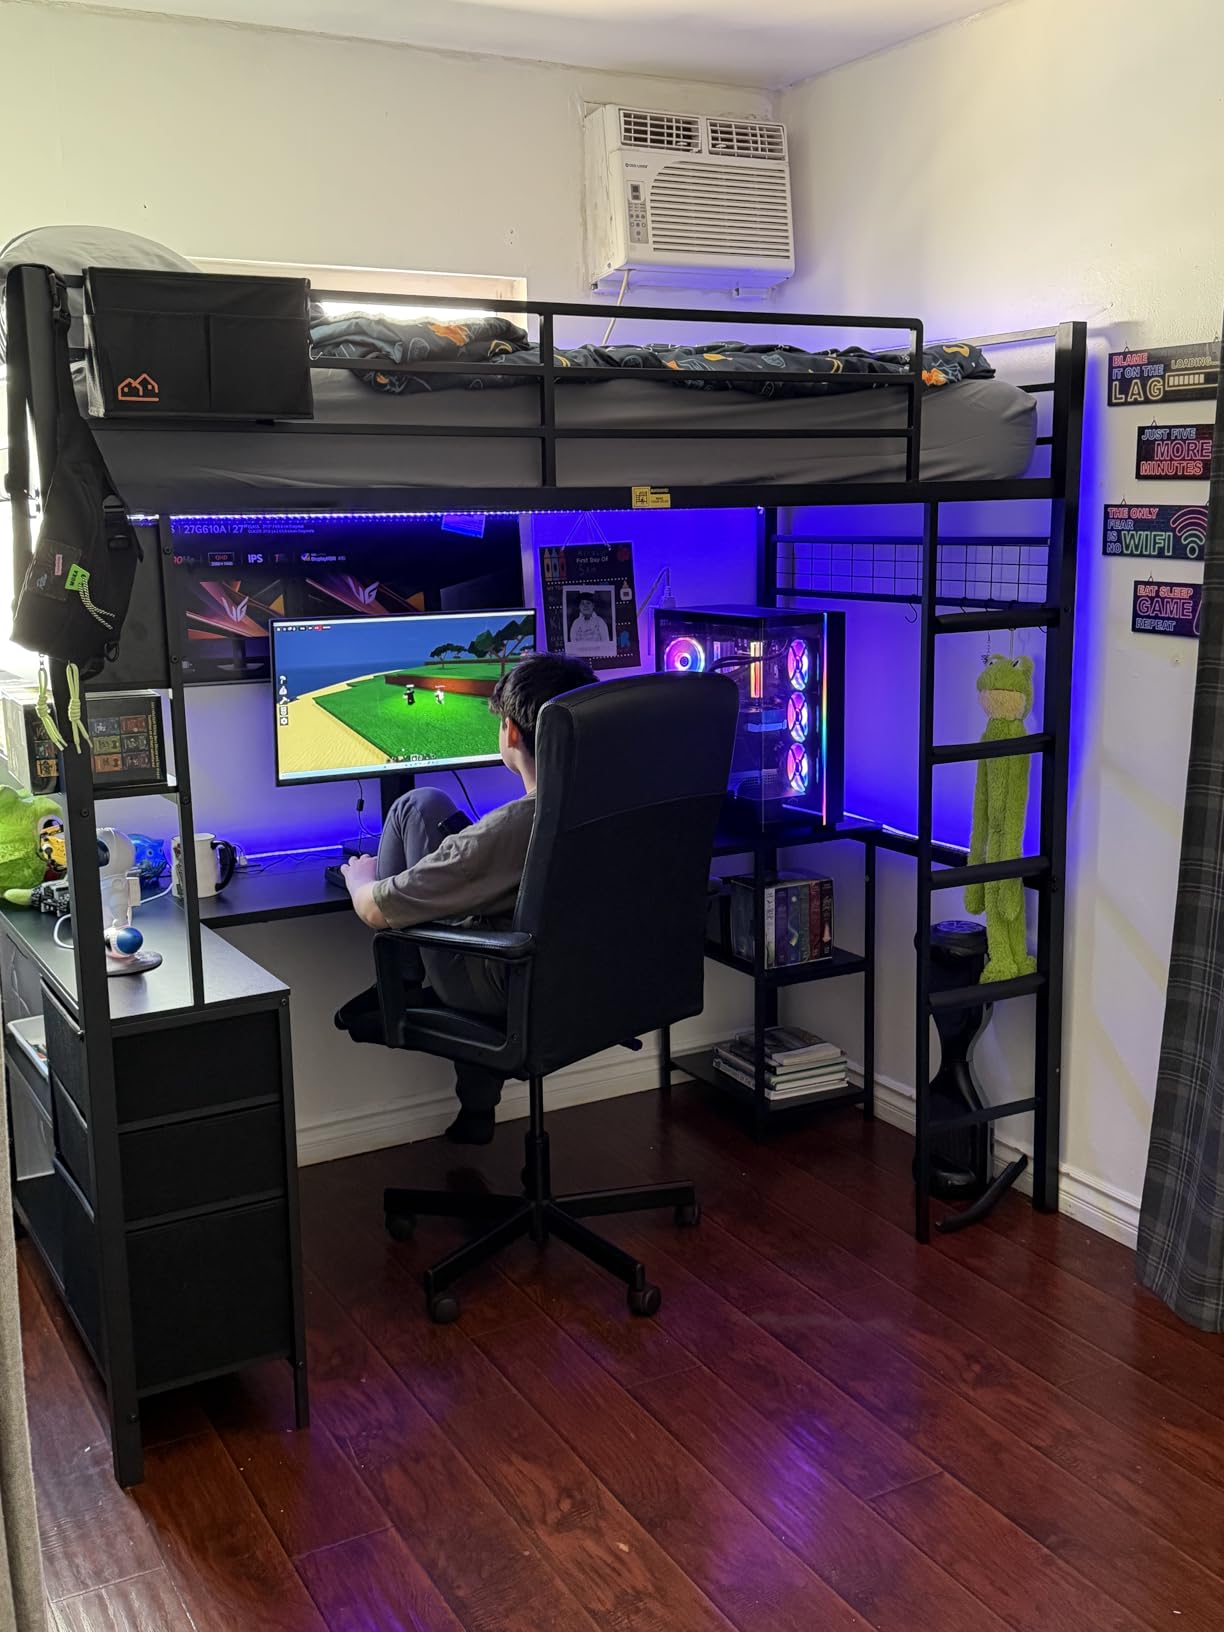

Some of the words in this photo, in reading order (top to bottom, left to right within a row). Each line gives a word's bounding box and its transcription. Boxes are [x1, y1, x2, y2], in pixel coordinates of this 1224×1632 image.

[1112, 352, 1148, 367] BLAME
[1112, 368, 1122, 379] IT
[1124, 367, 1140, 378] ON
[1142, 364, 1164, 376] THE
[1112, 378, 1163, 402] LAG
[1141, 429, 1170, 440] JUST
[1171, 428, 1197, 439] FIVE
[1155, 440, 1212, 460] MORE
[1140, 461, 1203, 476] MINUTES
[1107, 508, 1128, 518] THE
[1130, 508, 1159, 519] ONLY
[184, 524, 227, 534] 27G610A
[1107, 519, 1134, 530] FEAR
[1107, 531, 1118, 541] IS
[1107, 542, 1121, 554] NO
[1121, 531, 1173, 556] WIFI
[248, 554, 263, 564] IPS
[1137, 585, 1158, 596] EAT
[1159, 587, 1194, 598] SLEEP
[1136, 597, 1193, 619] GAME
[1136, 618, 1176, 631] REPEAT
